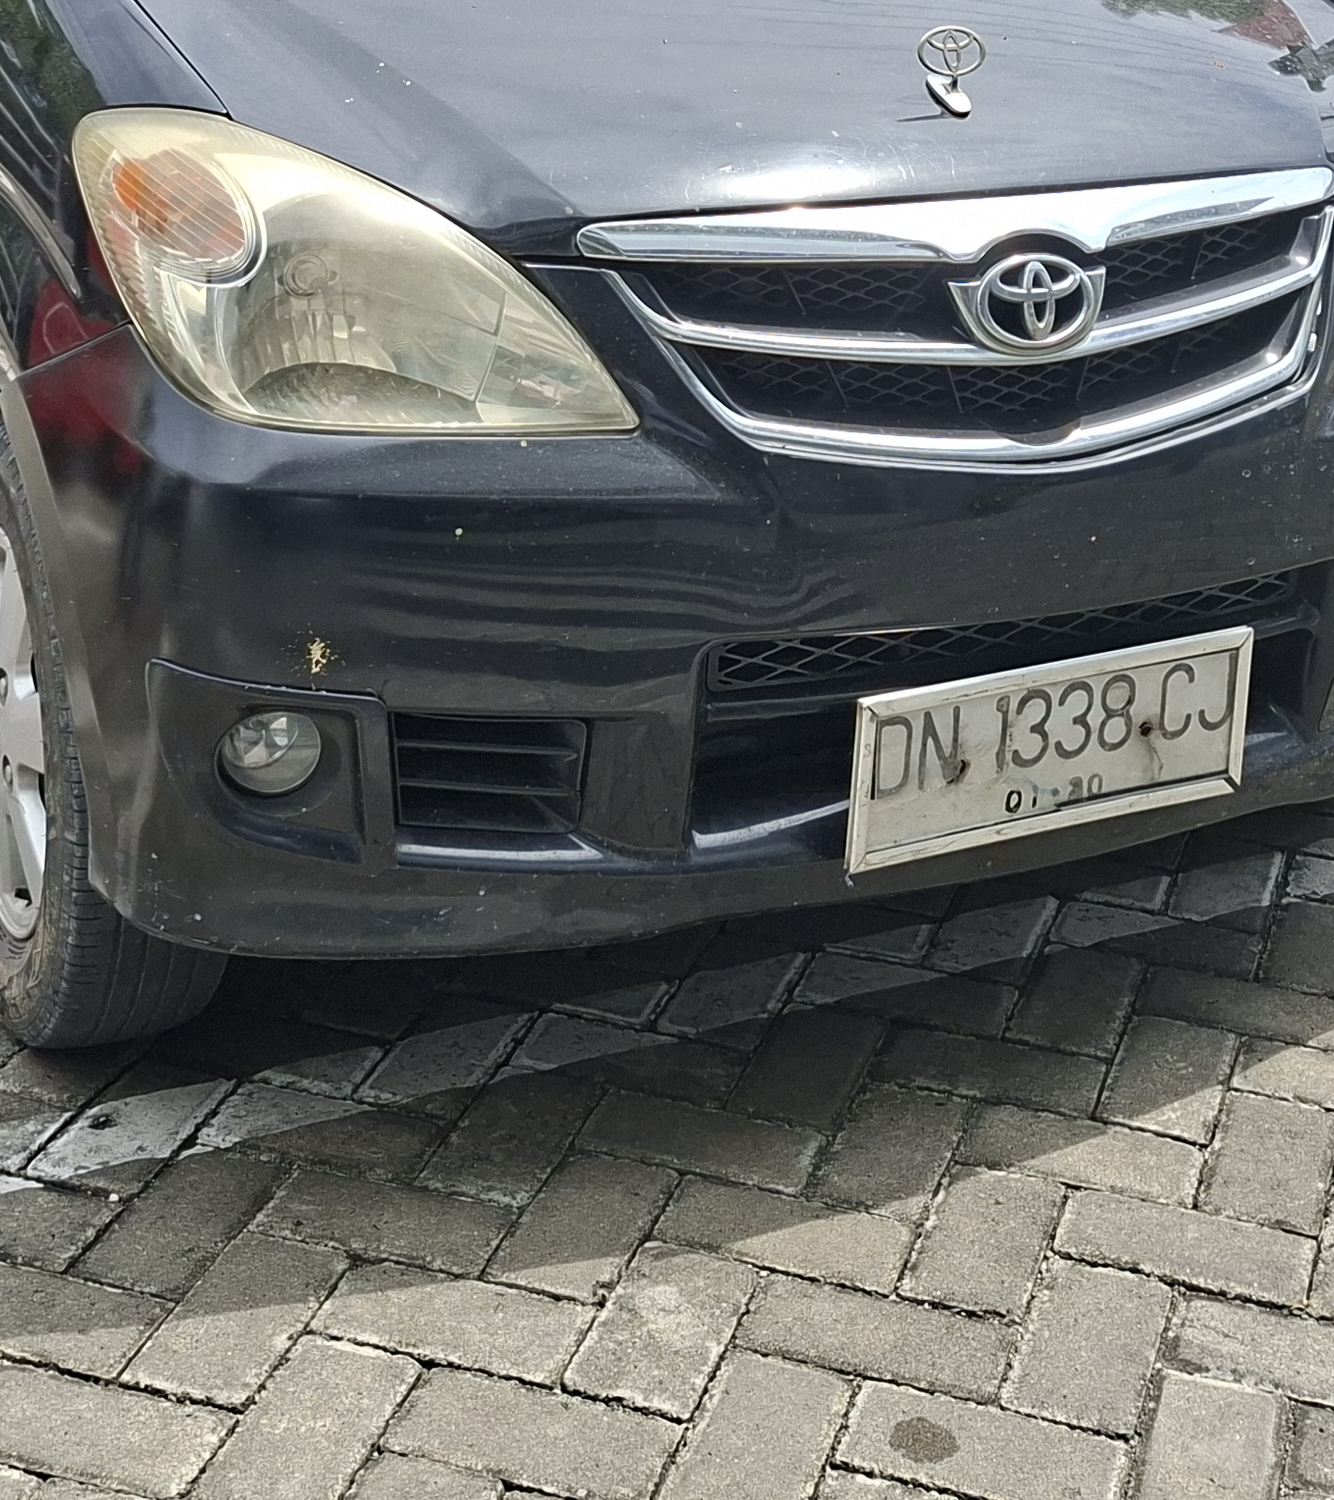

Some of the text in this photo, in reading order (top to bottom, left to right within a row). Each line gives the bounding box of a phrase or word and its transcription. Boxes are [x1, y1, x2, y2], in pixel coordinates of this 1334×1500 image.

[874, 652, 1239, 798] DN 1338 CJ
